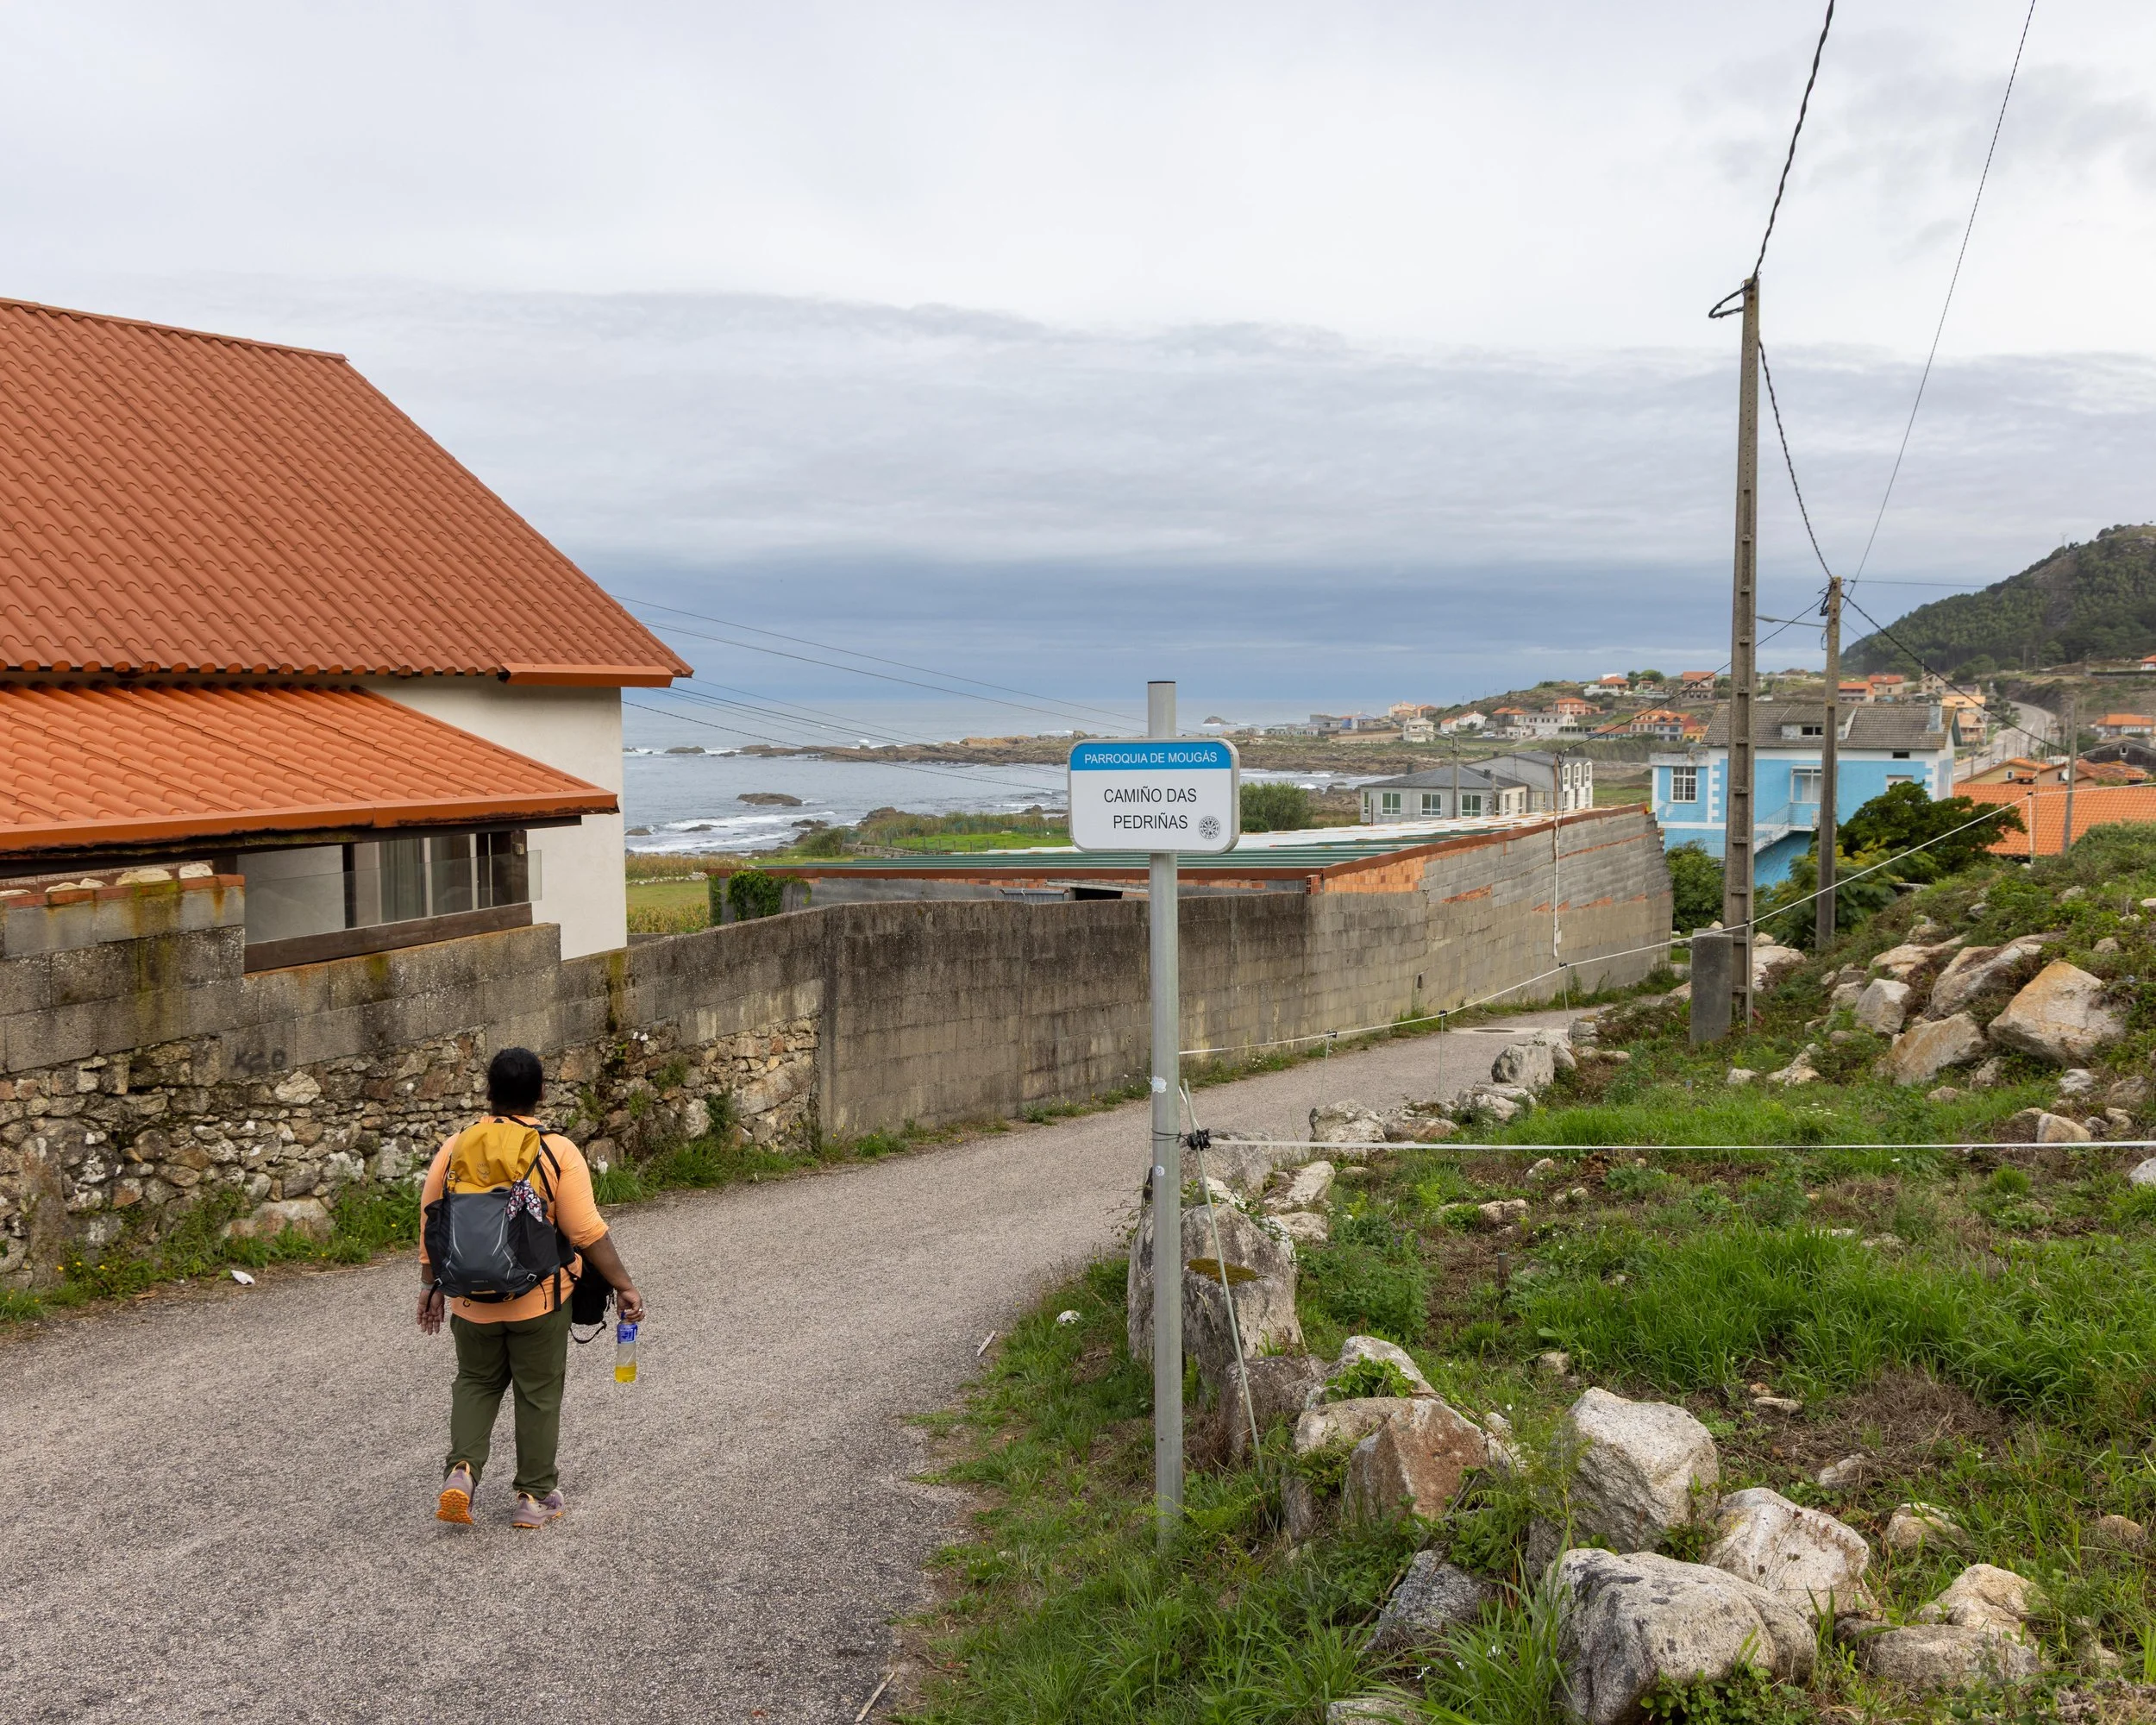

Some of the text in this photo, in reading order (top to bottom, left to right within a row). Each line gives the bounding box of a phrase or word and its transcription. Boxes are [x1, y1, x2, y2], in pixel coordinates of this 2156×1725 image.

[1084, 750, 1218, 764] PARROQUIA DE MOUGÁS
[1103, 786, 1197, 803] CAMIÑO DAS
[1113, 812, 1188, 830] PEDRIÑAS
